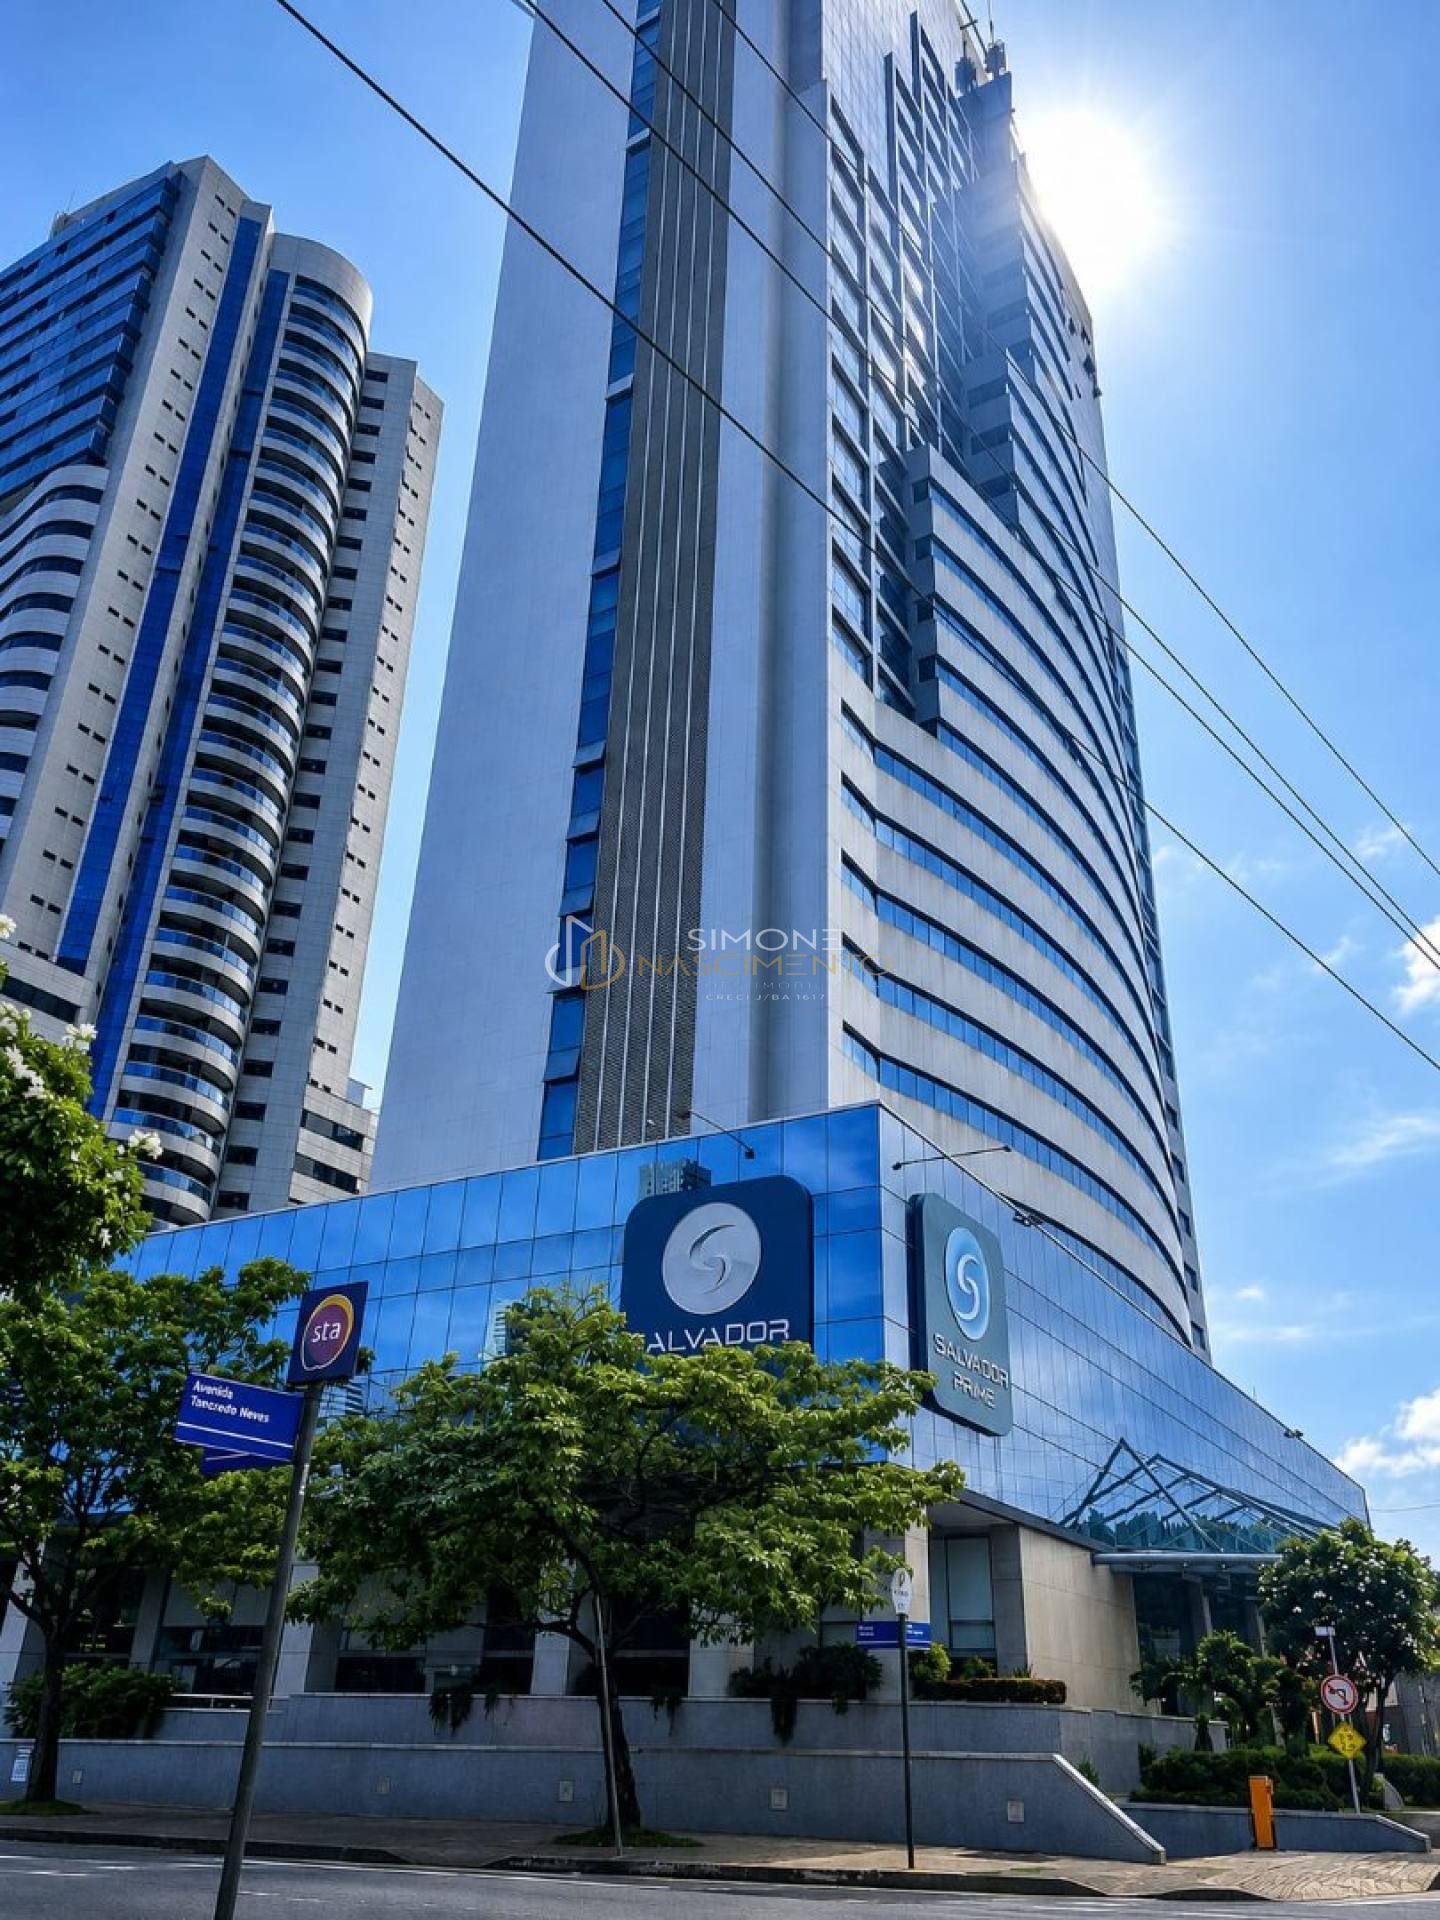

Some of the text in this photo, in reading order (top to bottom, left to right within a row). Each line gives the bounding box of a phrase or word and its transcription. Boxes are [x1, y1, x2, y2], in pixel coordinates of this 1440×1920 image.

[312, 1320, 341, 1343] sta
[646, 1318, 790, 1352] ALVADOR
[933, 1332, 1009, 1389] SALVADOR
[192, 1380, 234, 1400] Avenida
[953, 1370, 996, 1409] PRIME
[191, 1395, 270, 1423] Tancredo Neves
